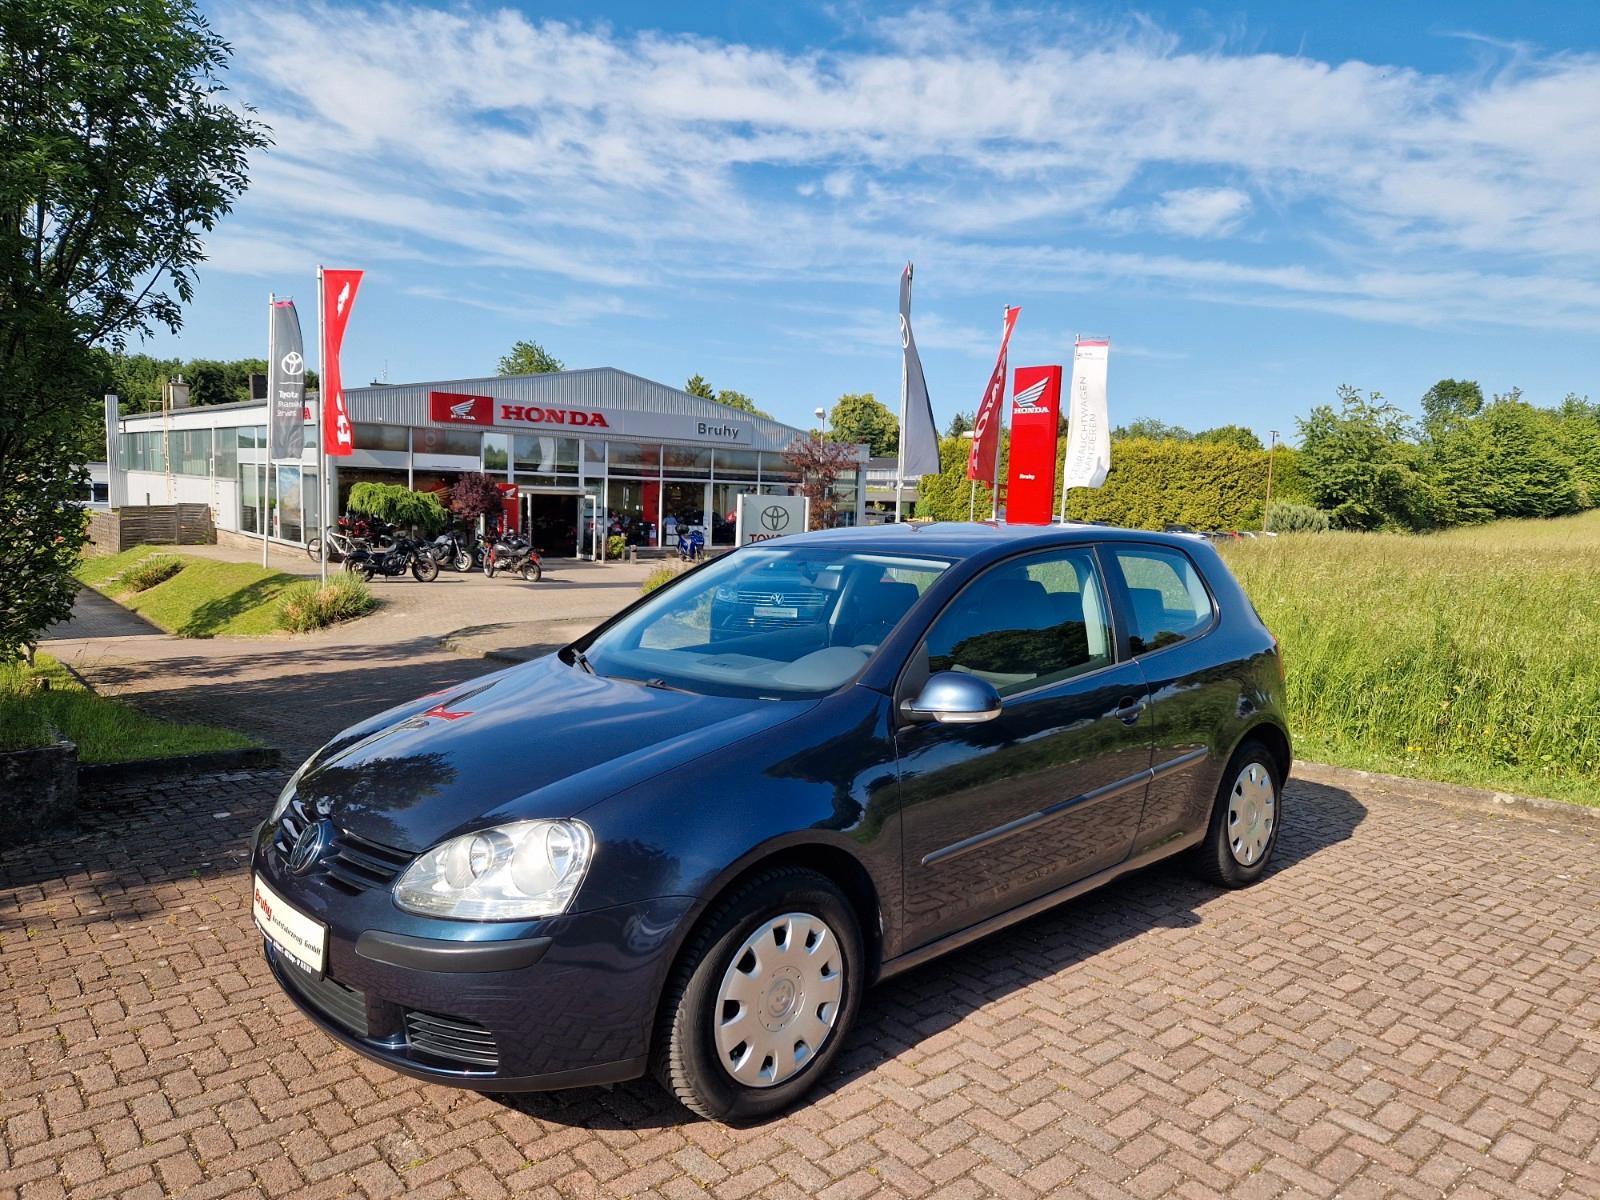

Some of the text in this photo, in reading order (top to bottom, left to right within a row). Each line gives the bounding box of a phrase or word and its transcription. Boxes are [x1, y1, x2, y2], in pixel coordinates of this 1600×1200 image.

[501, 405, 610, 428] HONDA
[1013, 406, 1049, 414] HONDA
[697, 422, 739, 440] Bruhy
[255, 888, 273, 922] Bruhy
